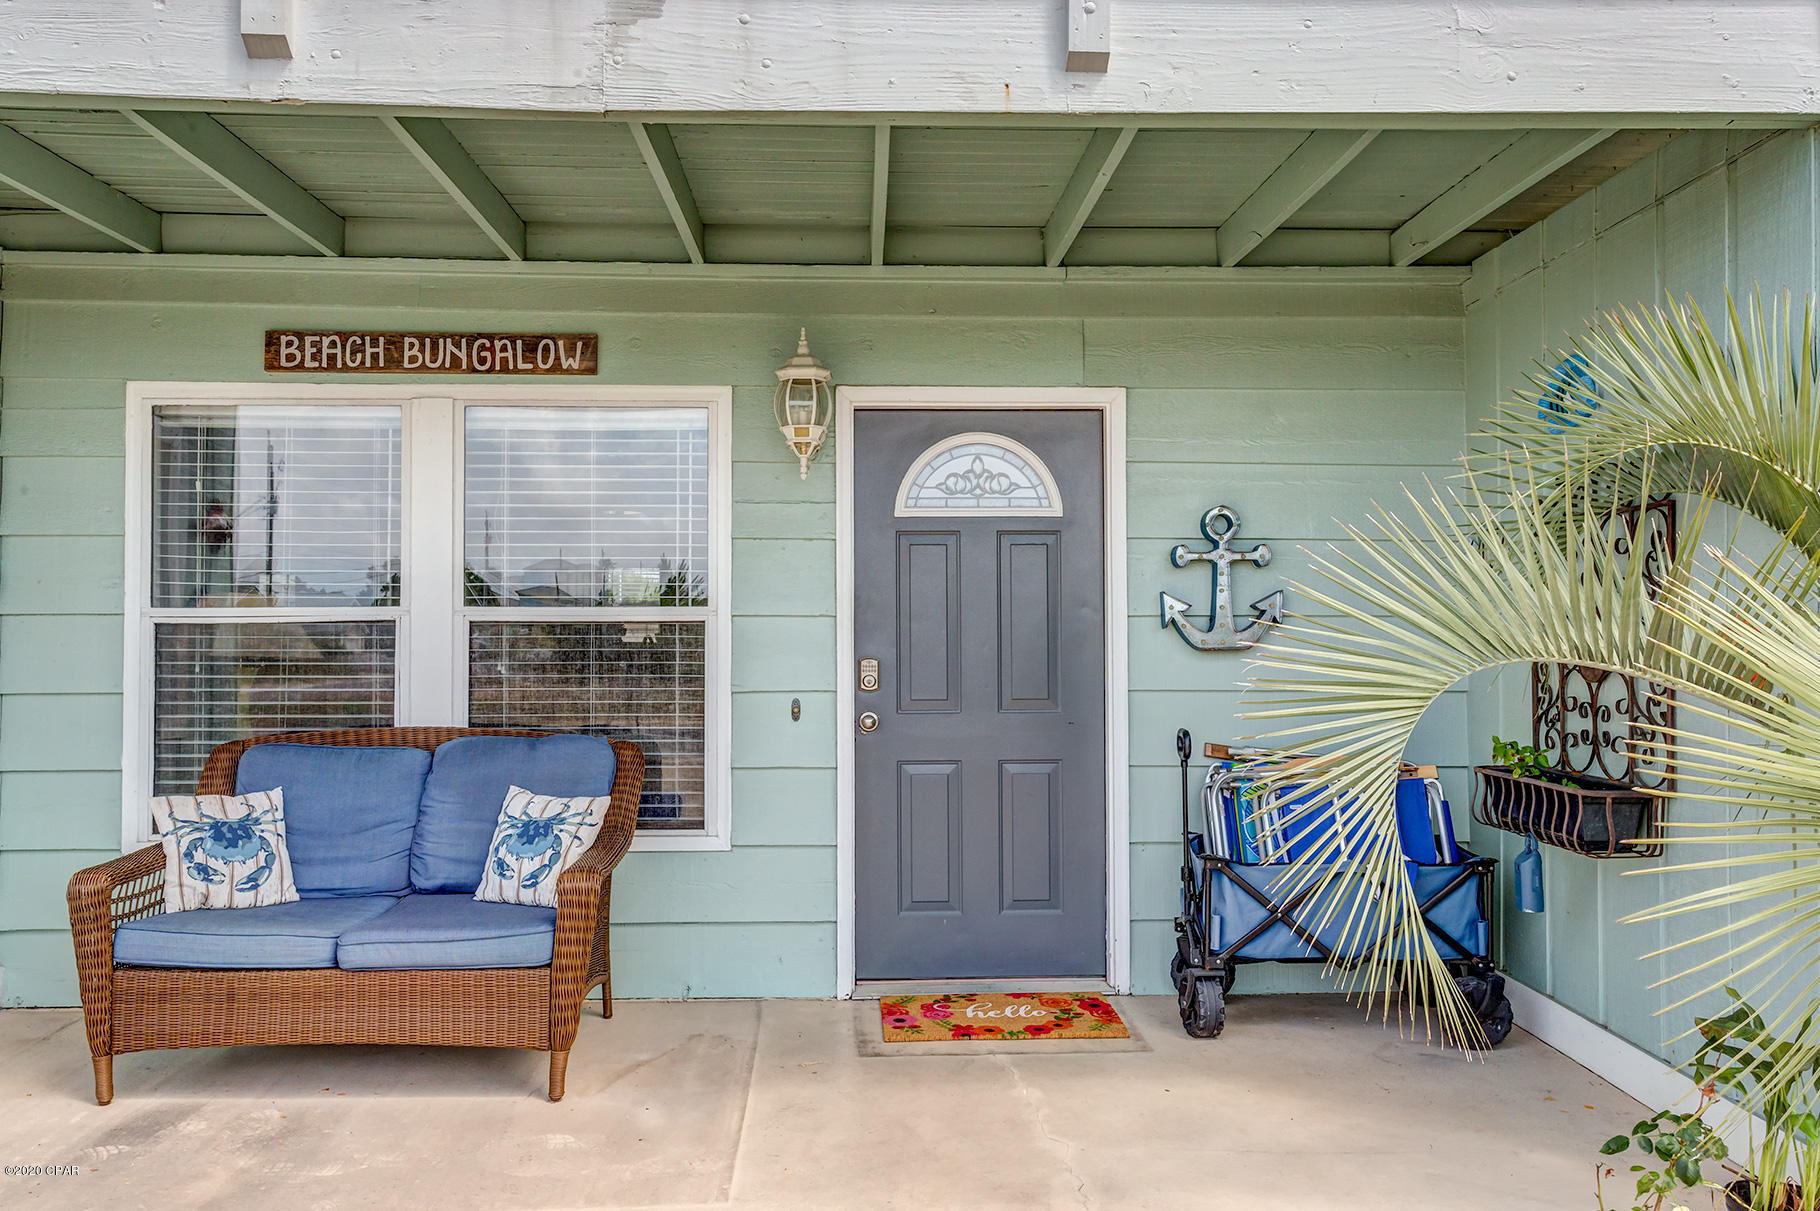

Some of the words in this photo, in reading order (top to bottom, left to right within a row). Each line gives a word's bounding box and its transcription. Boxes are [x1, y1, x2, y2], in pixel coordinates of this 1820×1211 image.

[279, 335, 385, 369] BEACH
[403, 337, 582, 371] BUNGALOW
[933, 1002, 1046, 1018] hello
